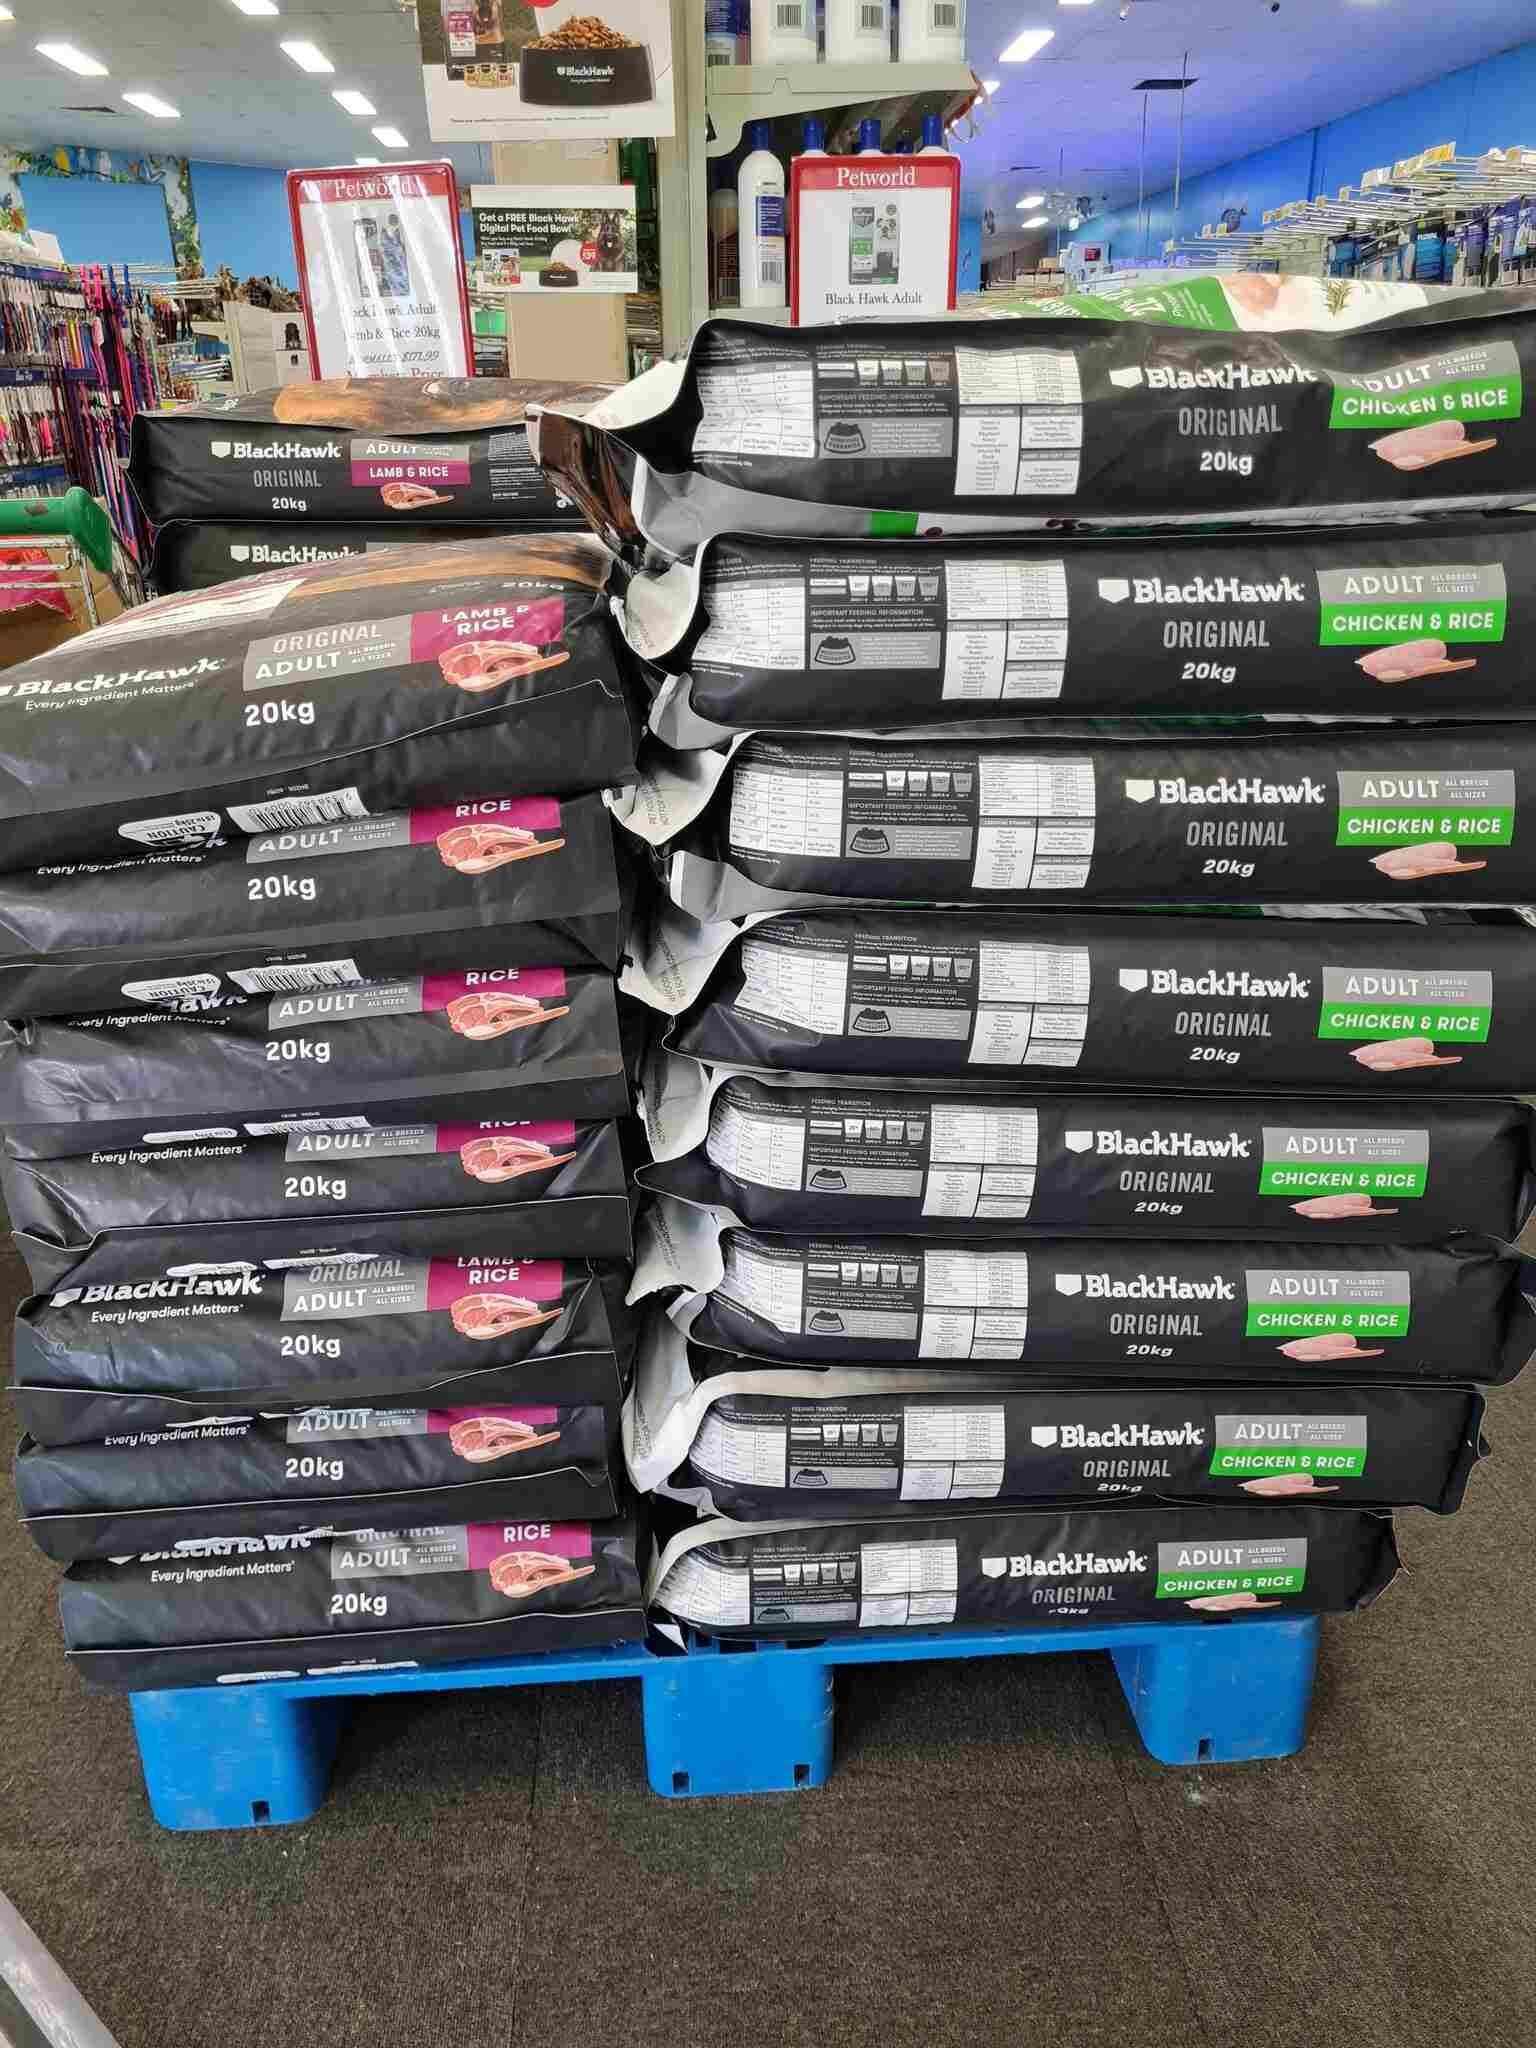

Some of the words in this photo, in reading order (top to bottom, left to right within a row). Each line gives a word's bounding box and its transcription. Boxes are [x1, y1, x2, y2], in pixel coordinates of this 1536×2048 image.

[566, 66, 615, 76] BlackHawk
[335, 175, 417, 198] Petwod
[836, 166, 916, 187] Petworld
[479, 213, 497, 222] Get
[505, 213, 527, 222] FREE
[529, 213, 553, 223] Black
[554, 214, 579, 223] Hawk
[479, 224, 509, 235] Digital
[511, 224, 526, 233] Pet
[527, 224, 549, 233] Food
[550, 225, 571, 233] Bowl
[825, 292, 855, 305] Black
[858, 292, 890, 305] Hawk
[892, 292, 922, 304] Adult
[415, 325, 440, 340] 20kg
[1147, 364, 1315, 391] BlackHawk
[1342, 396, 1437, 416] CHICKEN
[1442, 394, 1456, 411] &
[1461, 388, 1509, 409] RICE
[1178, 406, 1282, 437] ORIGINAL
[233, 442, 340, 460] BlackHawk
[366, 443, 418, 457] ADULT
[369, 466, 401, 479] LAMB
[407, 466, 415, 478] &
[418, 465, 449, 479] RICE
[1200, 451, 1253, 477] 20kg
[253, 470, 322, 488] ORIGINAL
[271, 496, 307, 512] 20kg
[1134, 577, 1302, 604] BlackHawk
[1344, 574, 1423, 594] ADULT
[442, 607, 507, 624] LAMB
[1333, 614, 1423, 632] CHICKEN
[1430, 614, 1441, 630] &
[1448, 612, 1495, 629] RICE
[457, 617, 514, 636] RICE
[1163, 621, 1270, 649] ORIGINAL
[272, 624, 384, 654] ORIGINAL
[256, 651, 341, 679] ADULT
[1182, 662, 1236, 684] 20kg
[10, 657, 220, 697] BlackHawk
[25, 697, 65, 712] Every
[67, 690, 138, 706] Ingredient
[141, 681, 194, 697] Matters
[244, 701, 315, 727] 20kg
[1160, 777, 1323, 804] BlackHawk
[1362, 779, 1439, 799] ADULT
[455, 800, 512, 818] RICE
[1186, 821, 1288, 847] ORIGINAL
[1347, 818, 1434, 834] CHICKEN
[1440, 818, 1451, 834] &
[1458, 818, 1501, 834] RICE
[258, 828, 343, 853] ADULT
[37, 866, 75, 875] Every
[148, 854, 202, 864] Matters
[1202, 859, 1255, 878] 20kg
[248, 875, 317, 900] 20kg
[466, 968, 519, 986] RICE
[1152, 969, 1308, 999] BlackHawk
[1346, 977, 1419, 997] ADULT
[279, 994, 359, 1018] ADULT
[107, 1013, 172, 1026] Ingredient
[1175, 1011, 1272, 1038] ORIGINAL
[1331, 1013, 1414, 1030] CHICKEN
[1421, 1015, 1431, 1031] &
[1438, 1016, 1480, 1032] RICE
[265, 1039, 331, 1063] 20kg
[1190, 1047, 1240, 1064] 20kg
[297, 1132, 375, 1152] ADULT
[1096, 1130, 1250, 1158] BlackHawk
[1286, 1136, 1358, 1155] ADULT
[91, 1151, 126, 1165] Every
[129, 1146, 192, 1163] Ingredient
[194, 1144, 243, 1157] Matters
[284, 1175, 347, 1199] 20kg
[1120, 1171, 1214, 1194] ORIGINAL
[1272, 1172, 1354, 1187] CHICKEN
[1359, 1172, 1369, 1187] &
[1375, 1174, 1416, 1189] RICE
[1135, 1201, 1183, 1216] 20kg
[308, 1260, 405, 1283] ORIGINAL
[468, 1267, 520, 1285] RICE
[81, 1272, 263, 1303] BlackHawk
[1086, 1274, 1235, 1300] BlackHawk
[1268, 1278, 1339, 1296] ADULT
[293, 1289, 367, 1313] ADULT
[91, 1310, 126, 1325] Every
[128, 1306, 189, 1322] Ingredient
[191, 1303, 240, 1316] Matters
[1256, 1313, 1337, 1327] CHICKEN
[1342, 1314, 1352, 1327] &
[1359, 1314, 1399, 1327] RICE
[1109, 1313, 1203, 1337] ORIGINAL
[280, 1334, 341, 1357] 20kg
[1126, 1345, 1174, 1357] 20kg
[297, 1411, 371, 1433] ADULT
[1235, 1423, 1302, 1440] ADULT
[105, 1433, 137, 1447] Every
[139, 1428, 199, 1444] Ingredient
[200, 1425, 247, 1440] Matters
[1060, 1422, 1202, 1449] BlackHawk
[284, 1457, 345, 1481] 20kg
[1083, 1459, 1171, 1478] ORIGINAL
[1222, 1456, 1296, 1468] CHICKEN
[1301, 1456, 1311, 1468] &
[1316, 1456, 1356, 1469] RICE
[503, 1524, 551, 1543] RICE
[339, 1547, 410, 1569] ADULT
[1010, 1550, 1147, 1577] BlackHawk
[1177, 1549, 1243, 1567] ADULT
[151, 1568, 184, 1583] Every
[185, 1564, 245, 1581] Ingredient
[247, 1560, 293, 1575] Matters
[1164, 1576, 1237, 1591] CHICKEN
[1242, 1577, 1252, 1588] &
[1257, 1575, 1295, 1588] RICE
[330, 1594, 387, 1616] 20kg
[1032, 1586, 1116, 1604] ORIGINAL
